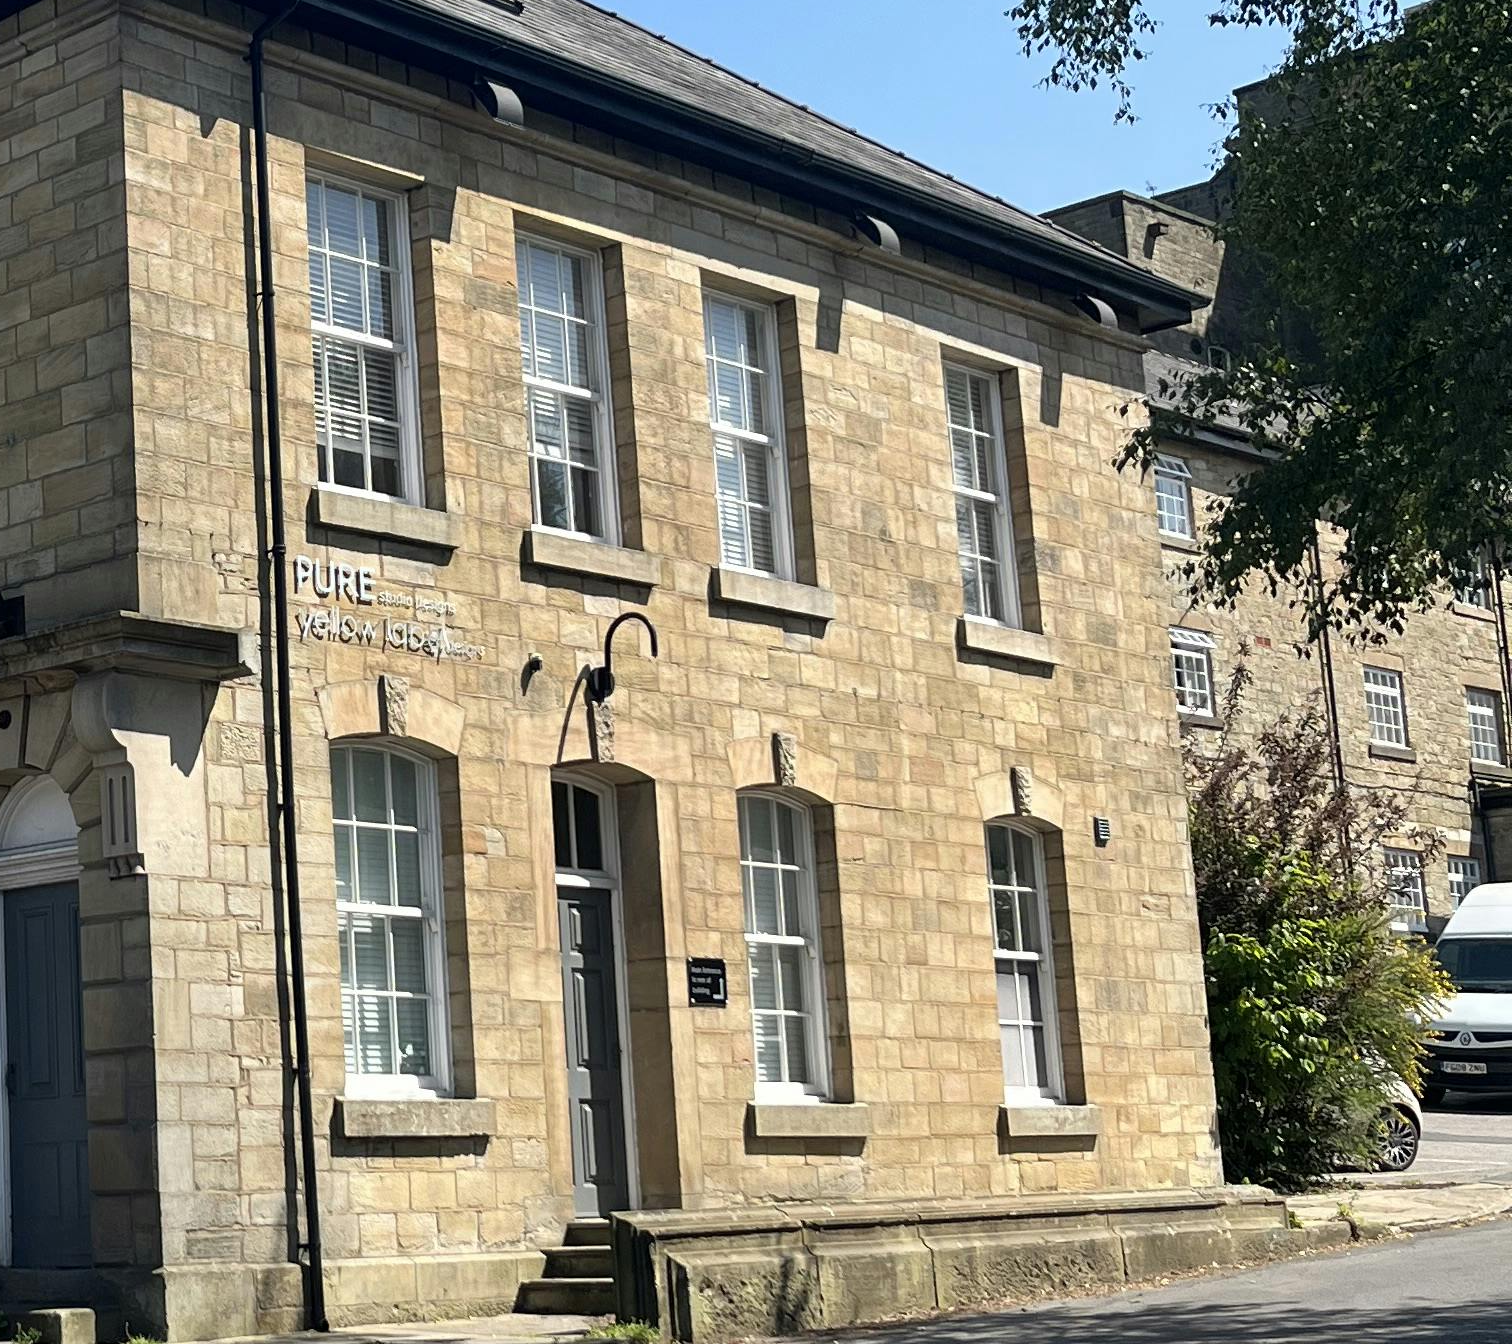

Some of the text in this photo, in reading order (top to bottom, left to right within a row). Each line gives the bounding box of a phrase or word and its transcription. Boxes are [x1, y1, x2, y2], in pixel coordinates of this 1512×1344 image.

[294, 554, 376, 602] PURE
[377, 590, 412, 608] studio
[296, 605, 377, 640] yellow
[385, 614, 450, 658] label
